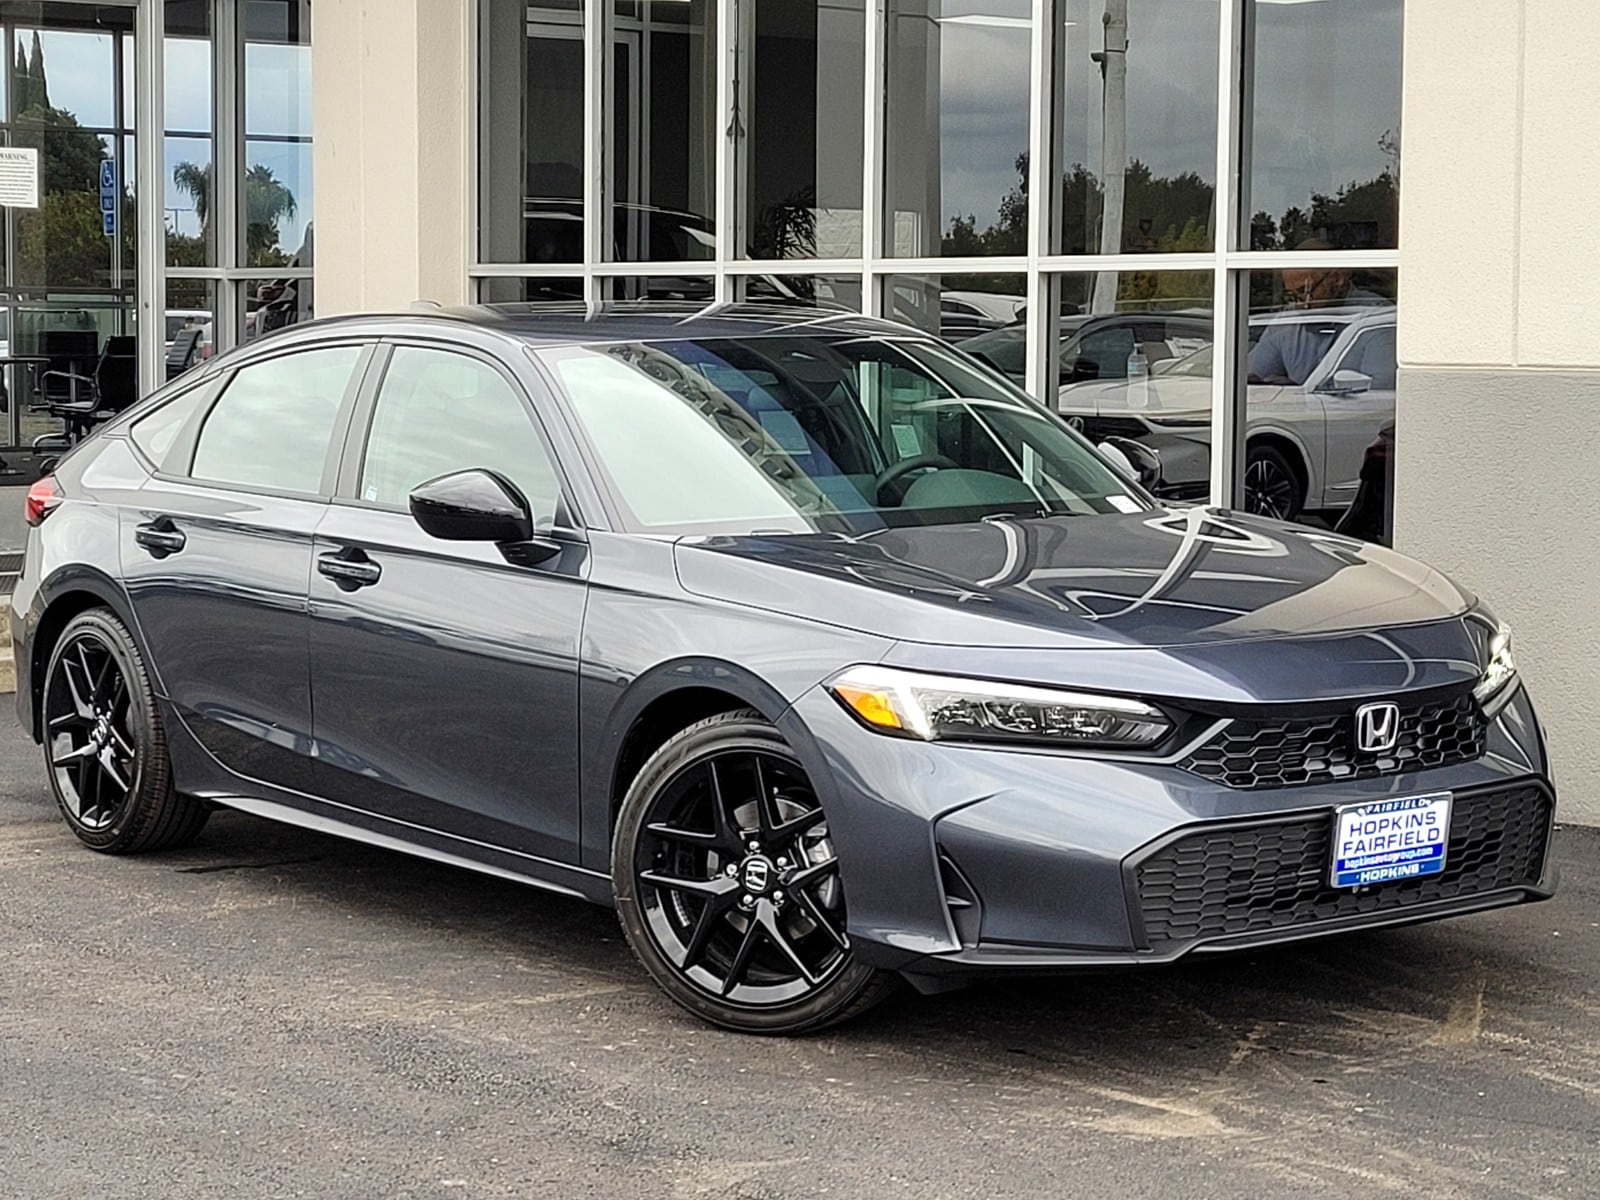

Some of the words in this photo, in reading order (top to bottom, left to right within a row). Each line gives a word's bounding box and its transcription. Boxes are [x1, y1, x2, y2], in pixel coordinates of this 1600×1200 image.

[1366, 799, 1426, 814] FAIRFIELD
[1349, 811, 1436, 837] HOPKINS
[1343, 827, 1440, 856] FAIRFIELD
[1360, 863, 1419, 882] HOPKINS
